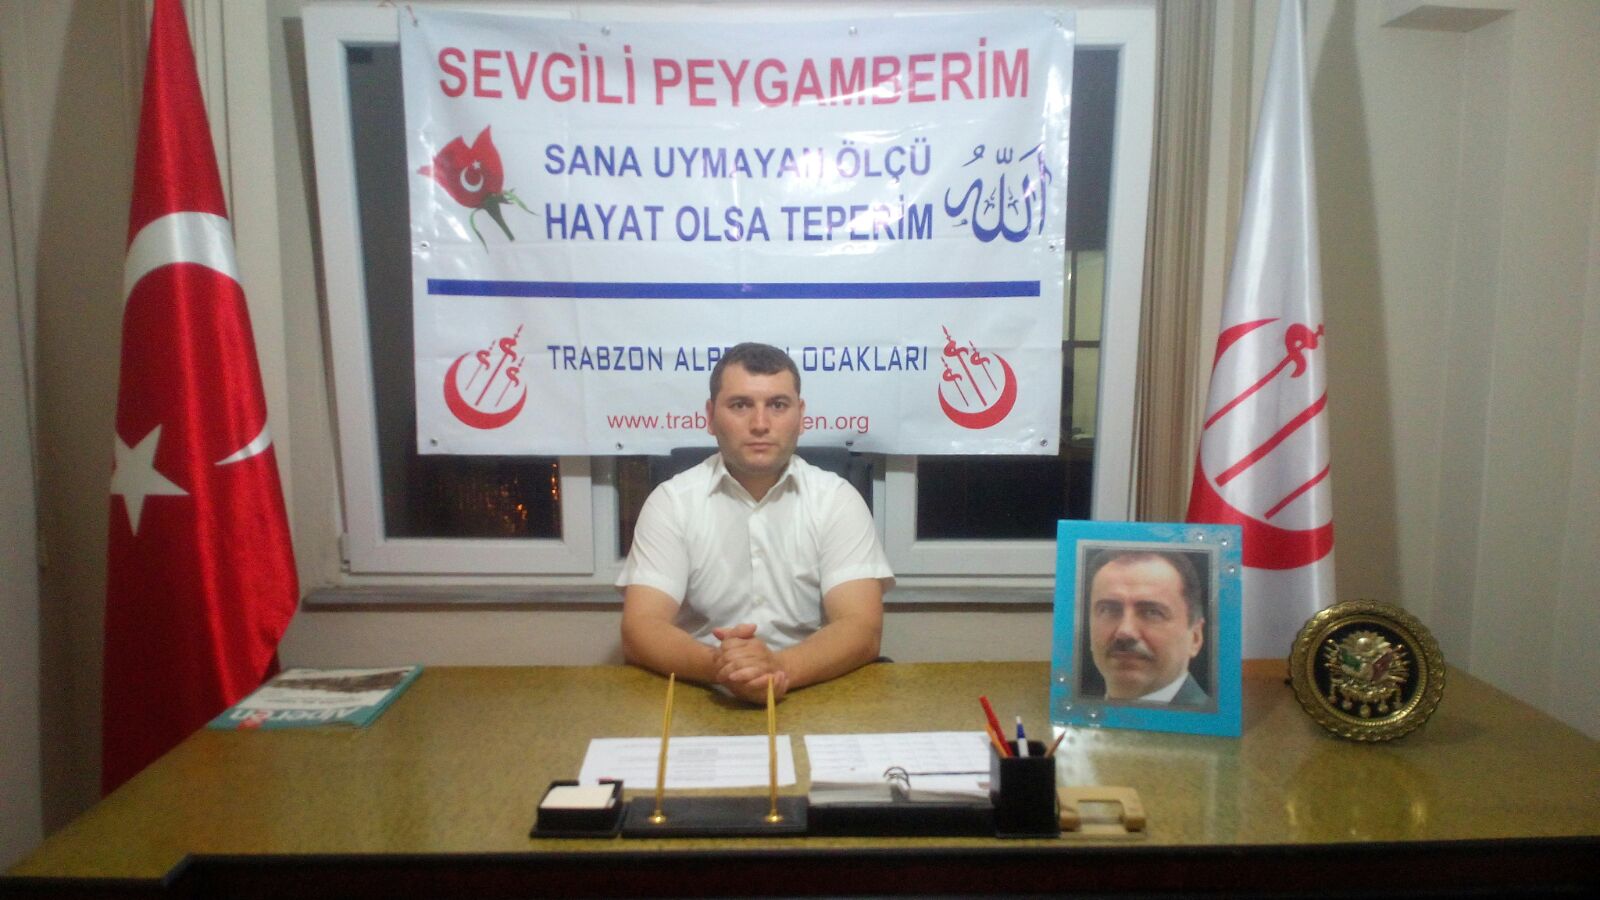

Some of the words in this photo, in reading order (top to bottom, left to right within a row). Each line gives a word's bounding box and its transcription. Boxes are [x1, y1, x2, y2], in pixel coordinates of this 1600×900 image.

[438, 42, 636, 104] SEVGİLİ
[653, 37, 1030, 108] PEYGAMBERİM
[544, 143, 643, 177] SANA
[836, 137, 932, 184] ÖLÇÜ
[544, 203, 664, 241] HAYAT
[675, 205, 771, 242] OLSA
[780, 194, 934, 242] TEPERİM
[547, 345, 664, 371] TRABZON
[803, 346, 928, 372] OCAKLARI
[606, 410, 870, 434] www.traben.org
